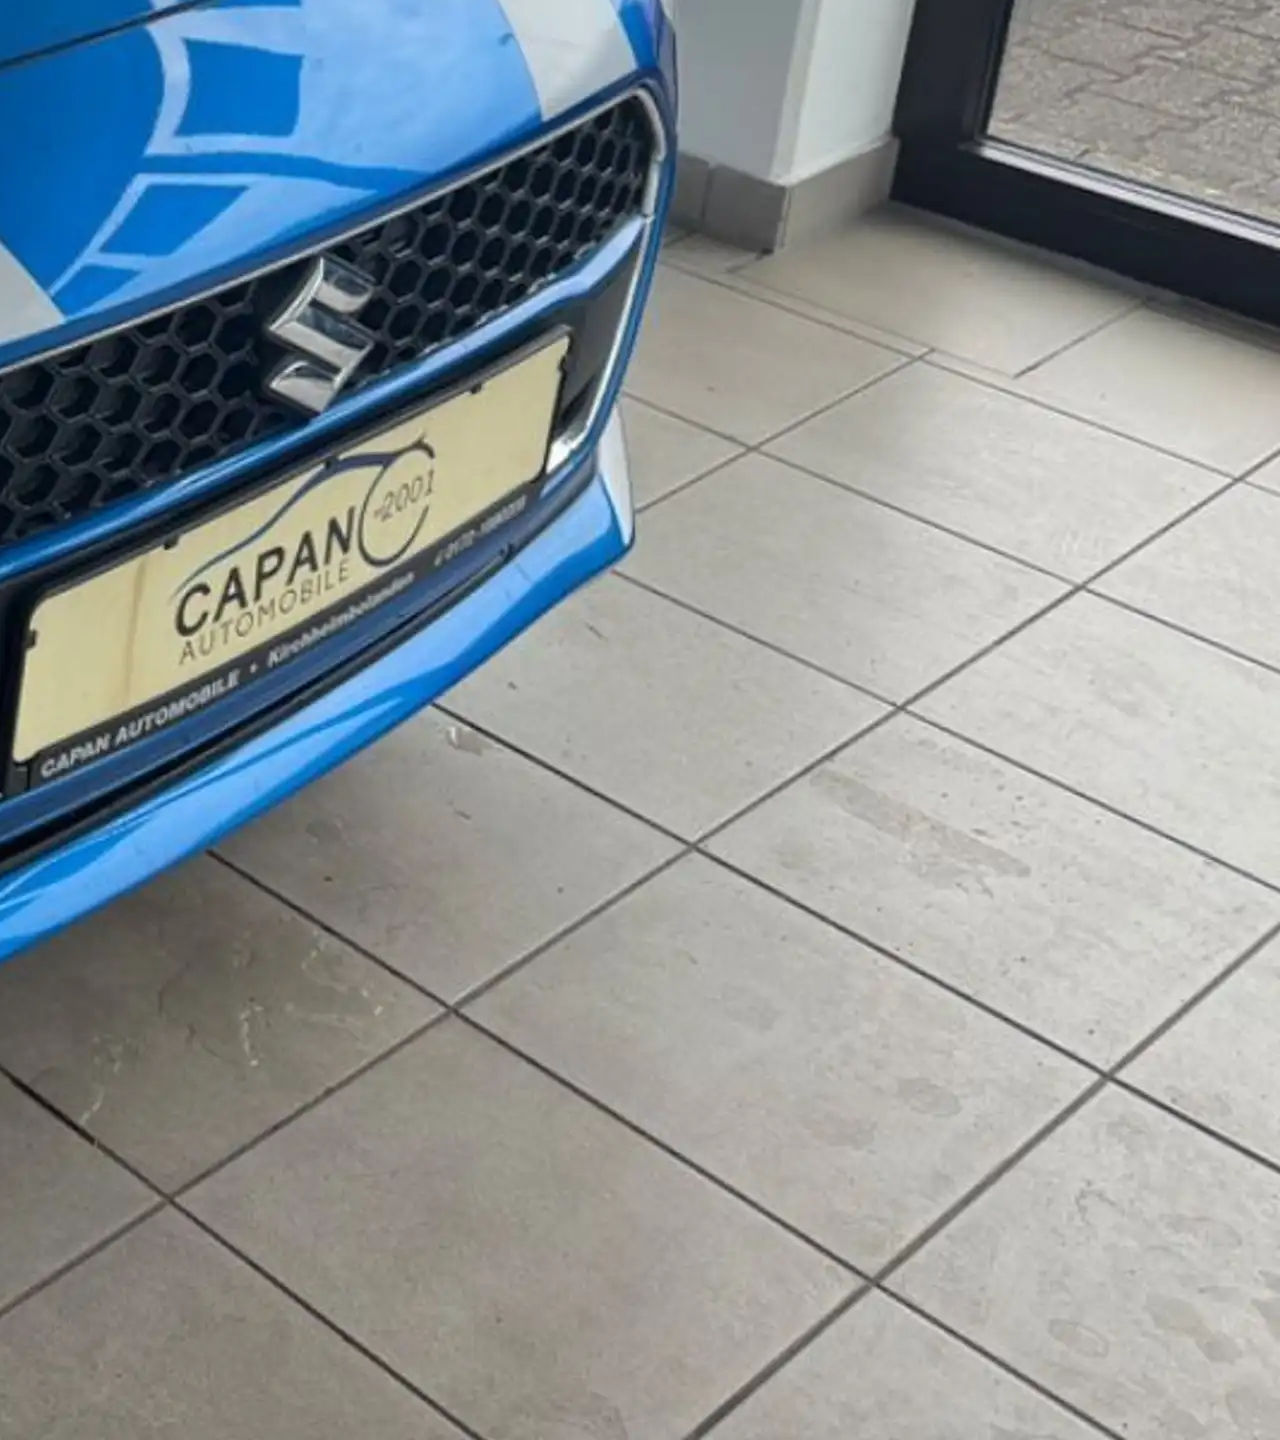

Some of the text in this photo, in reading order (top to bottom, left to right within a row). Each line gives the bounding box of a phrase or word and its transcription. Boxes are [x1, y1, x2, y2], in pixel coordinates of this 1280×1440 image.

[174, 505, 356, 637] CAPAN
[178, 563, 351, 666] AUTOMOBILE
[41, 733, 111, 778] CAPAN
[114, 668, 240, 747] AUTOMOBILE
